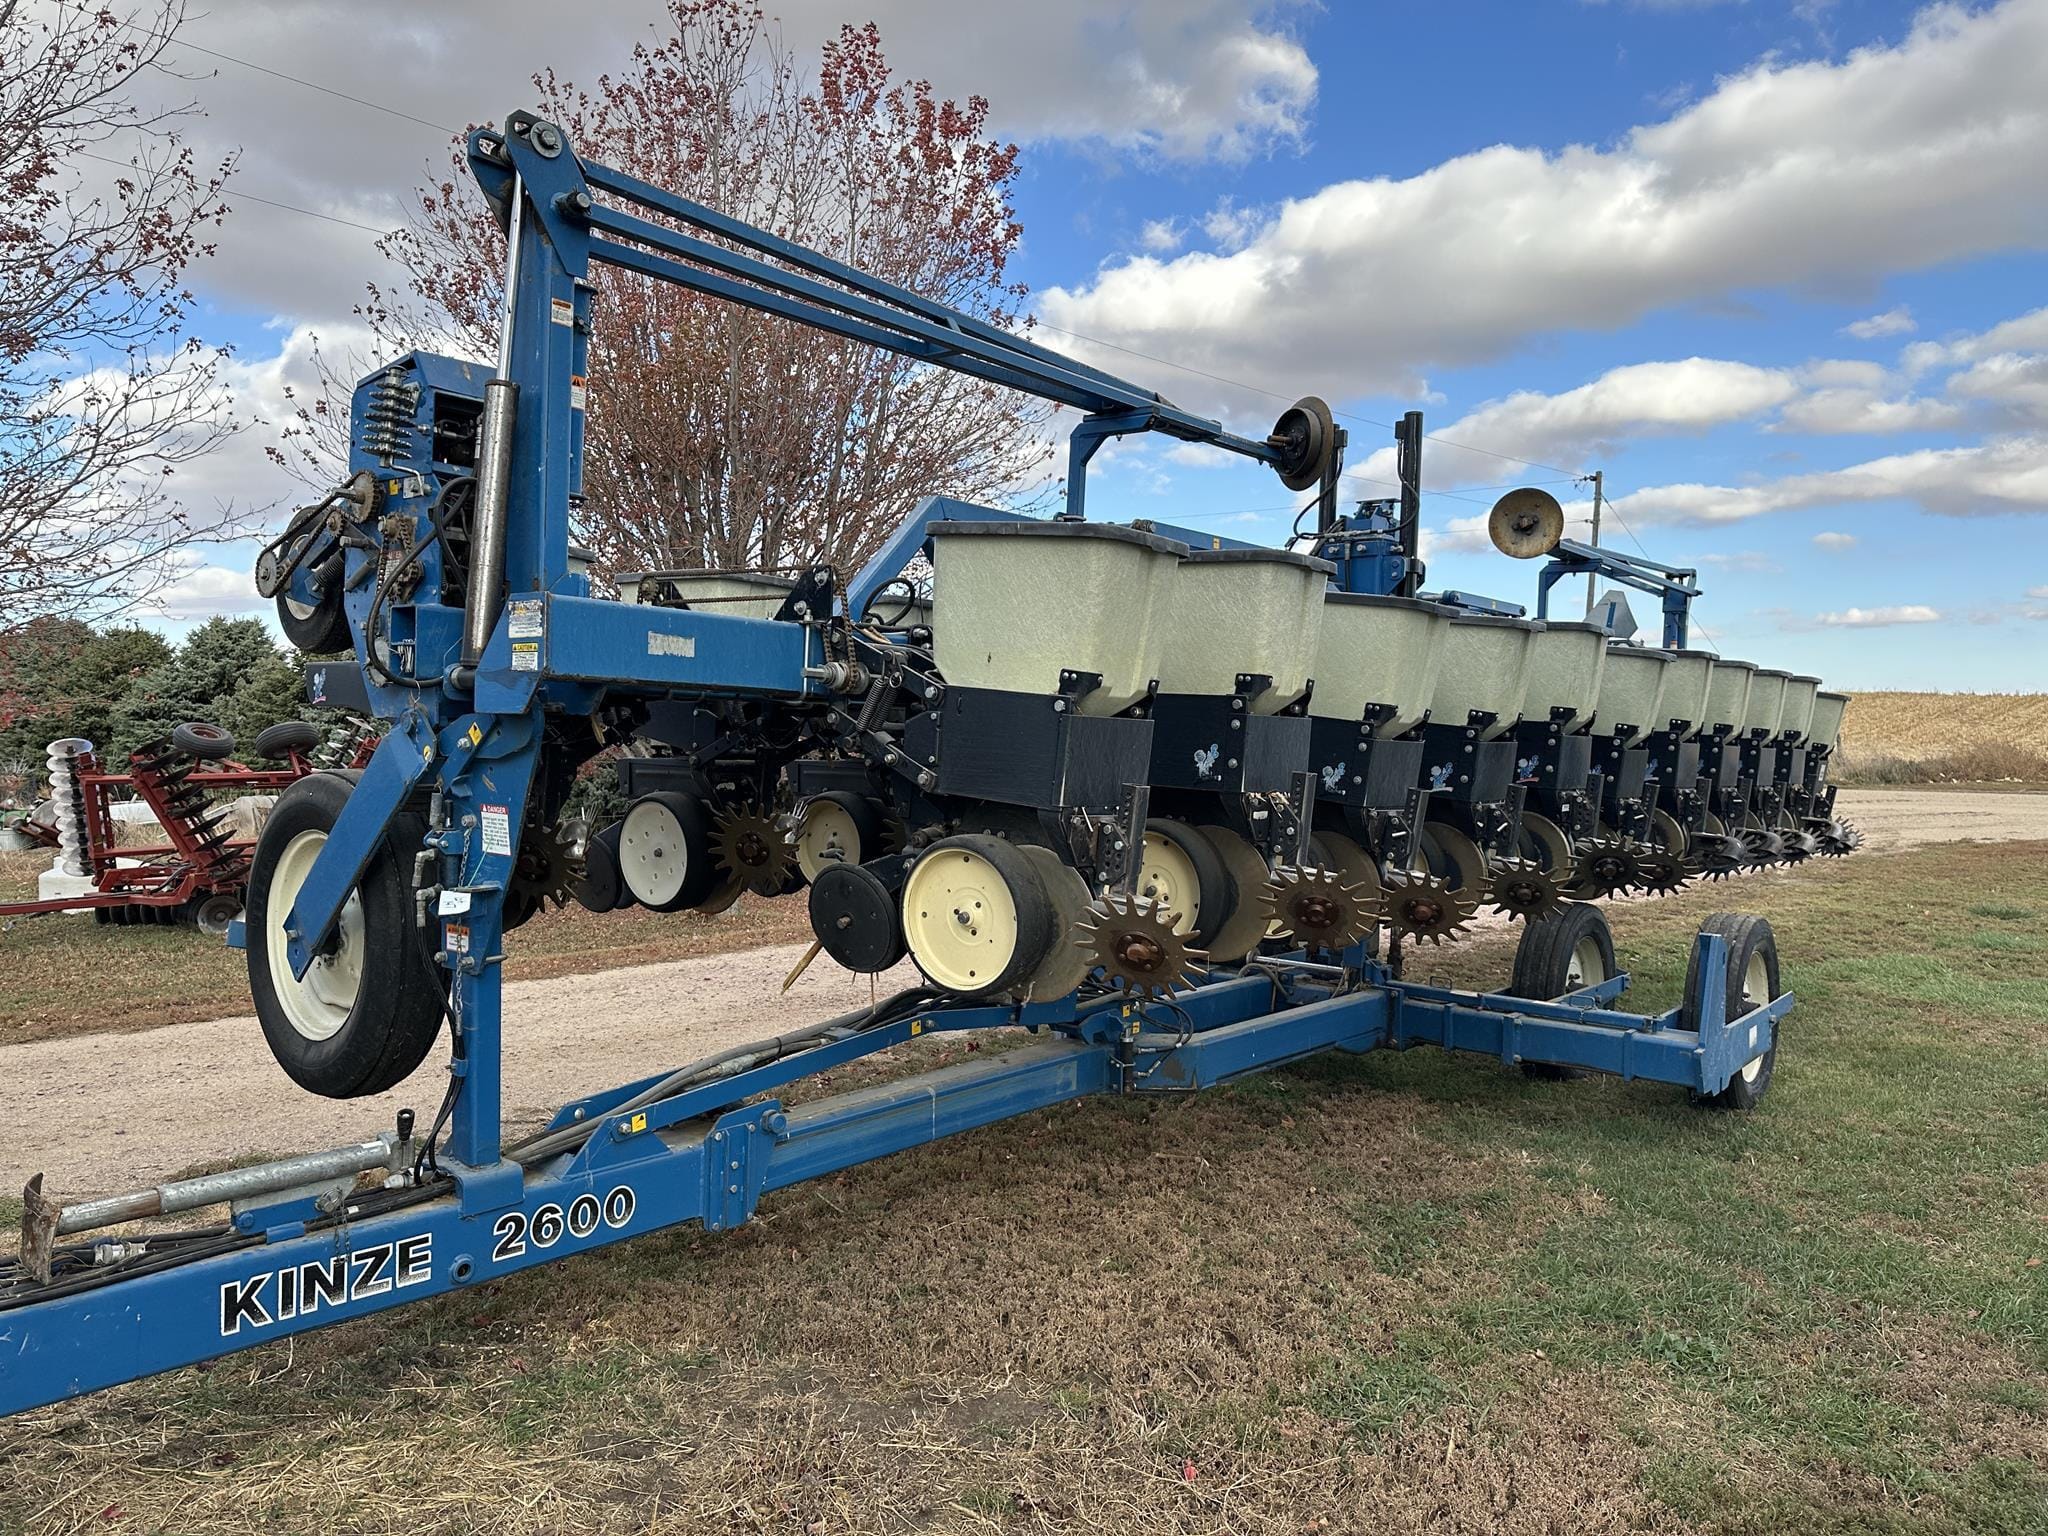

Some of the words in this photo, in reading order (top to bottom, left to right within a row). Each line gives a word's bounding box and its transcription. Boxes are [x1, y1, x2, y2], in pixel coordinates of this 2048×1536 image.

[487, 805, 506, 813] DANGER
[220, 1232, 433, 1336] KINZE
[492, 1184, 636, 1263] 2600
